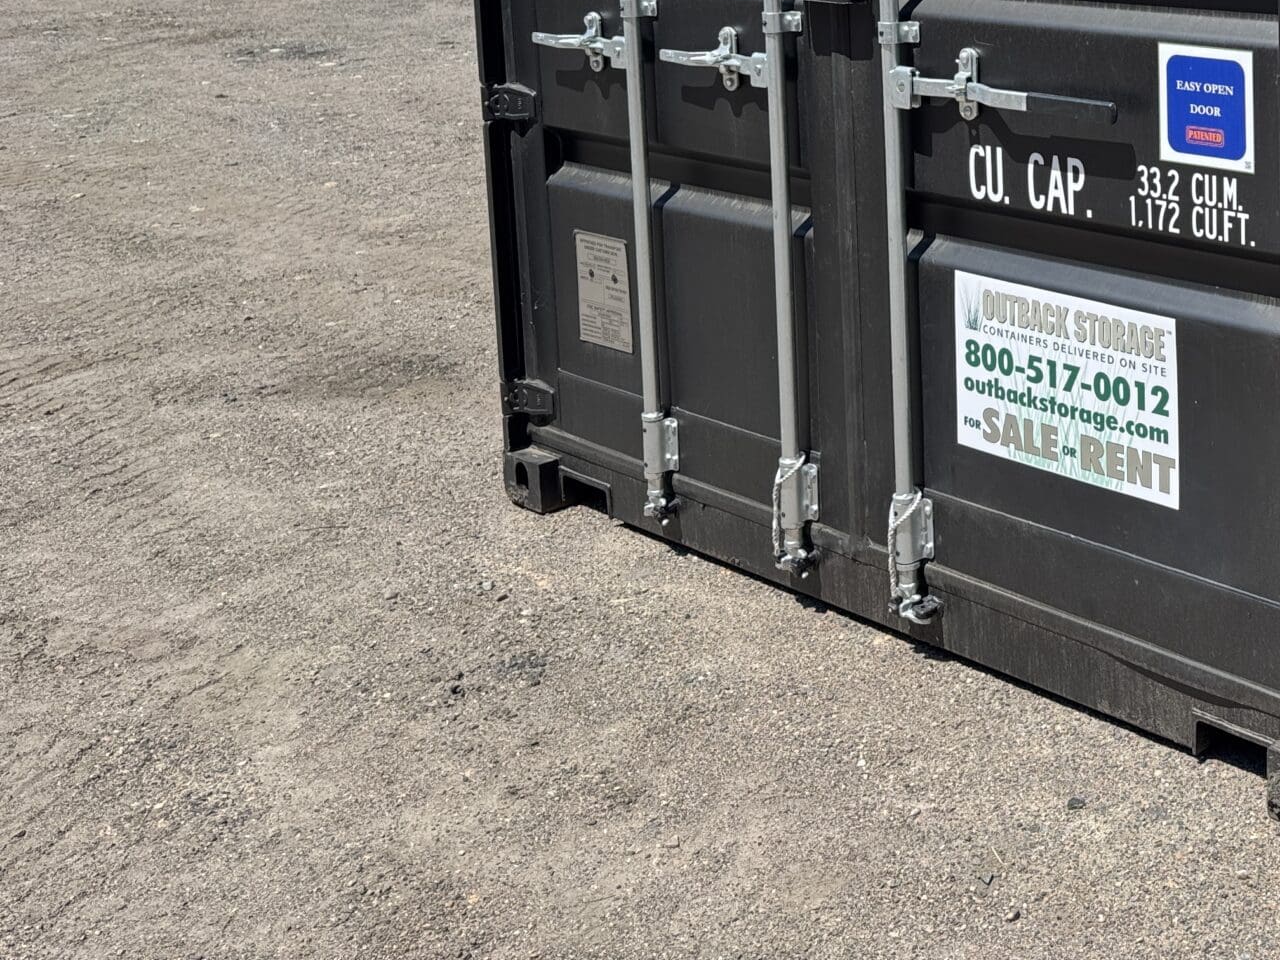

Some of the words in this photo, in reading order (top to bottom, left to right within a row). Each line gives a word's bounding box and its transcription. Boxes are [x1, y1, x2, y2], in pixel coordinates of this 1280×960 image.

[1176, 80, 1202, 92] EASY
[1203, 83, 1234, 96] OPEN
[1189, 103, 1222, 117] DOOR
[1187, 129, 1222, 144] PATENTED
[968, 144, 1010, 205] CU.
[1027, 152, 1093, 218] CAP.
[1137, 165, 1181, 201] 33.2
[1191, 172, 1243, 211] CU.M.
[1129, 195, 1181, 235] 1,172
[1191, 207, 1256, 248] CU.FT.
[982, 288, 1070, 340] OUTBACK
[1073, 310, 1167, 363] STORAGE
[982, 325, 1049, 349] CONTAINERS
[1052, 341, 1115, 365] DELIVERED
[1119, 357, 1136, 370] ON
[1141, 362, 1167, 377] SITE
[964, 338, 1170, 418] 800-517-0012
[964, 376, 1169, 444] outbackstorage.com
[963, 415, 982, 431] FOR
[982, 407, 1059, 462] SALE
[1062, 445, 1077, 459] OR
[1080, 435, 1176, 495] RENT
